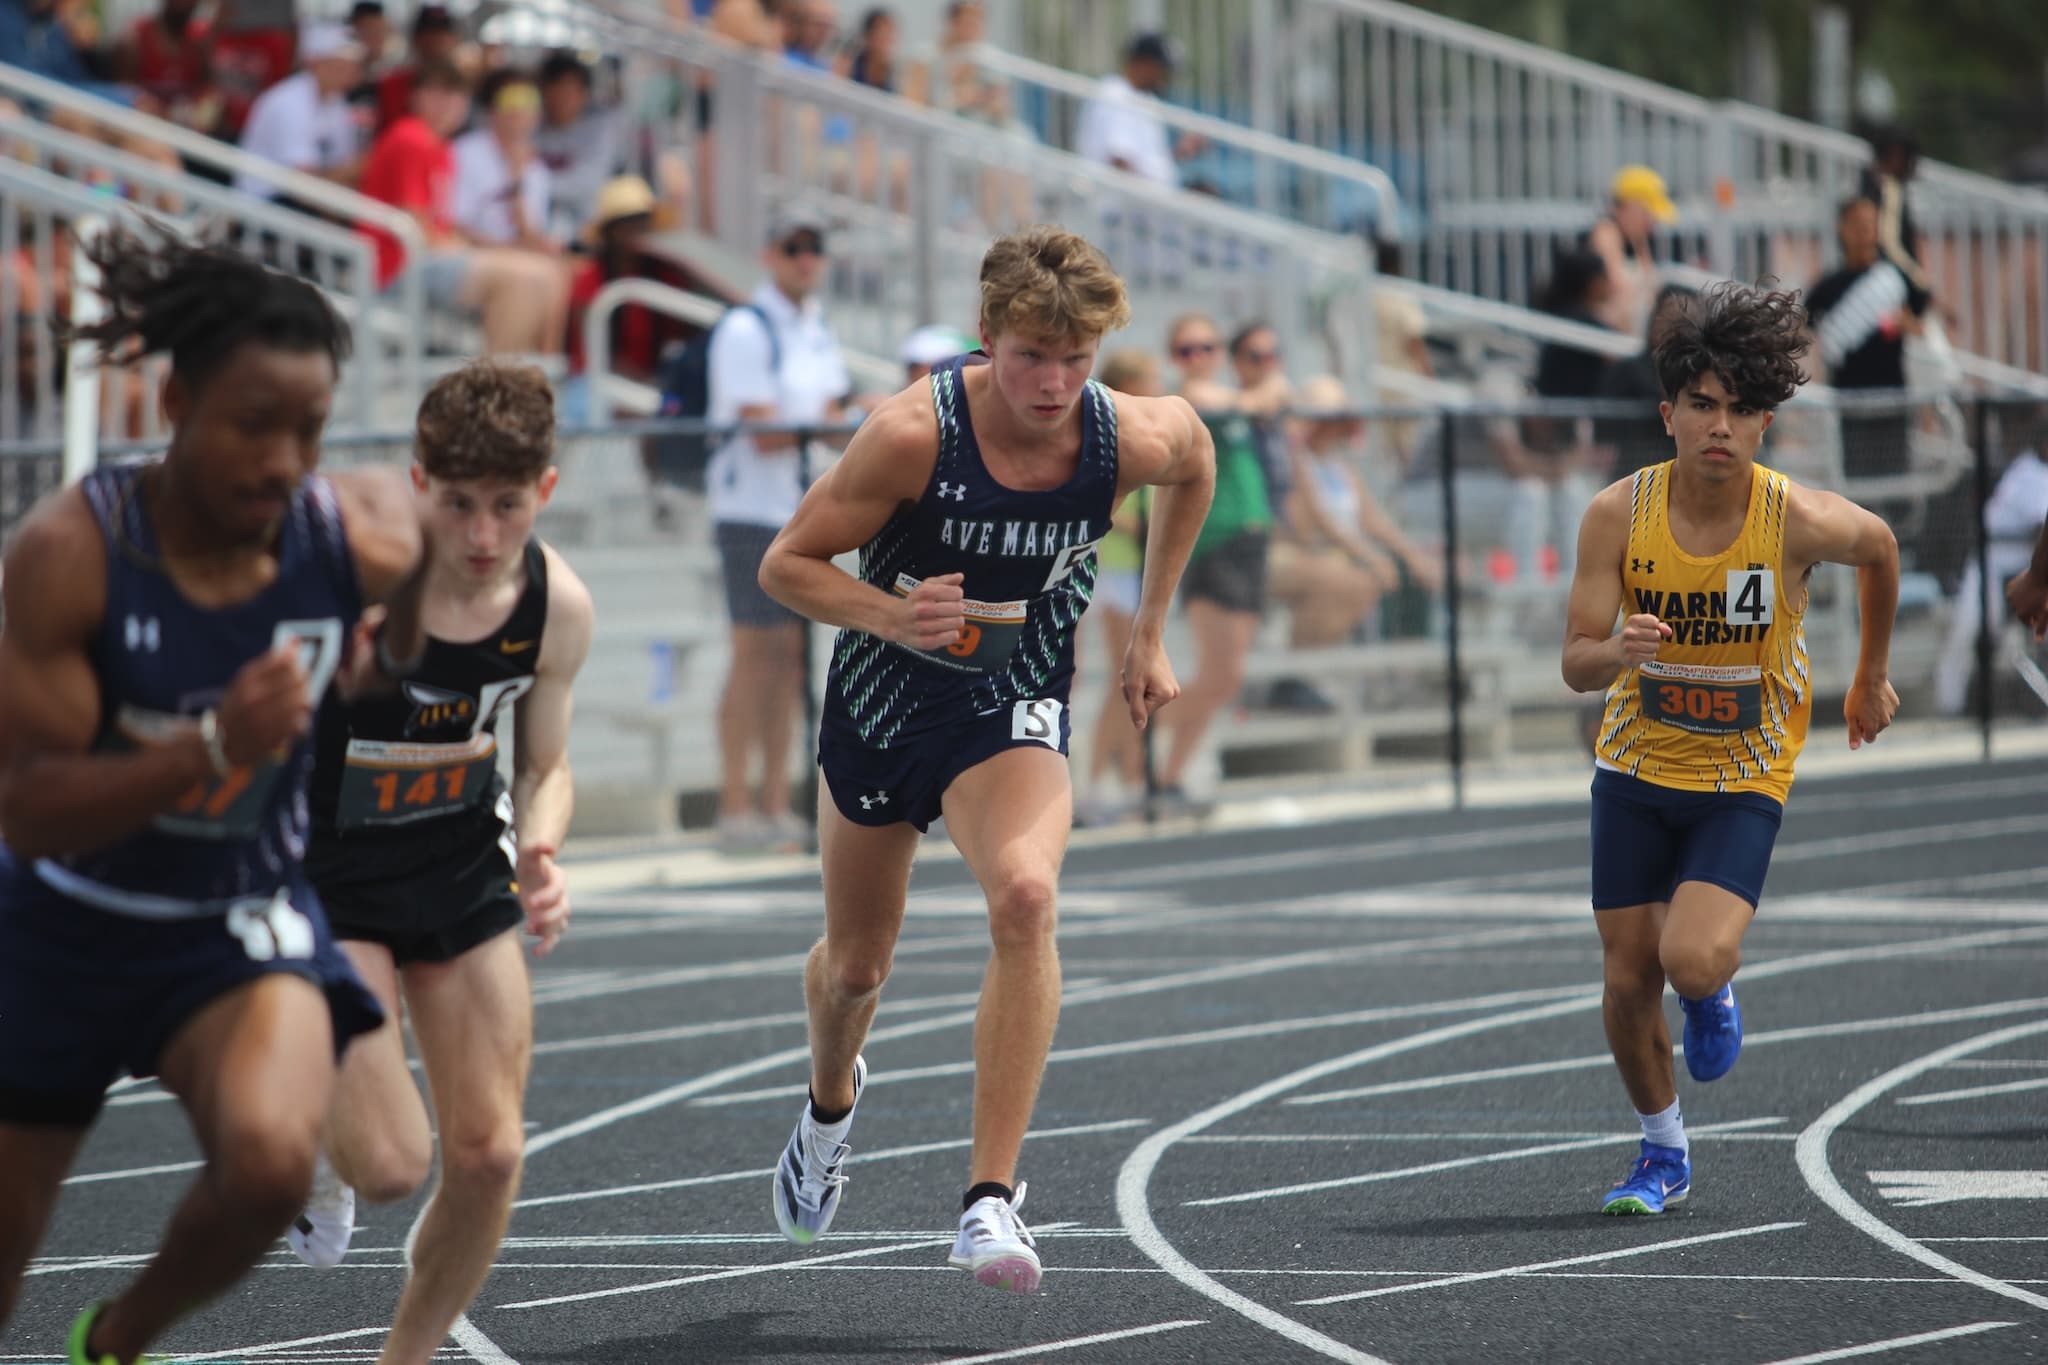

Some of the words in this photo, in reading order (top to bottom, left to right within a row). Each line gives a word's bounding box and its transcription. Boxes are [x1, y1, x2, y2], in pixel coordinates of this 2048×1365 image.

[941, 518, 993, 554] AVE
[1001, 520, 1089, 556] MARIA
[1634, 587, 1728, 619] WARN
[1735, 574, 1766, 621] 4
[1024, 700, 1053, 738] 5
[1659, 684, 1739, 722] 305
[371, 765, 468, 813] 141
